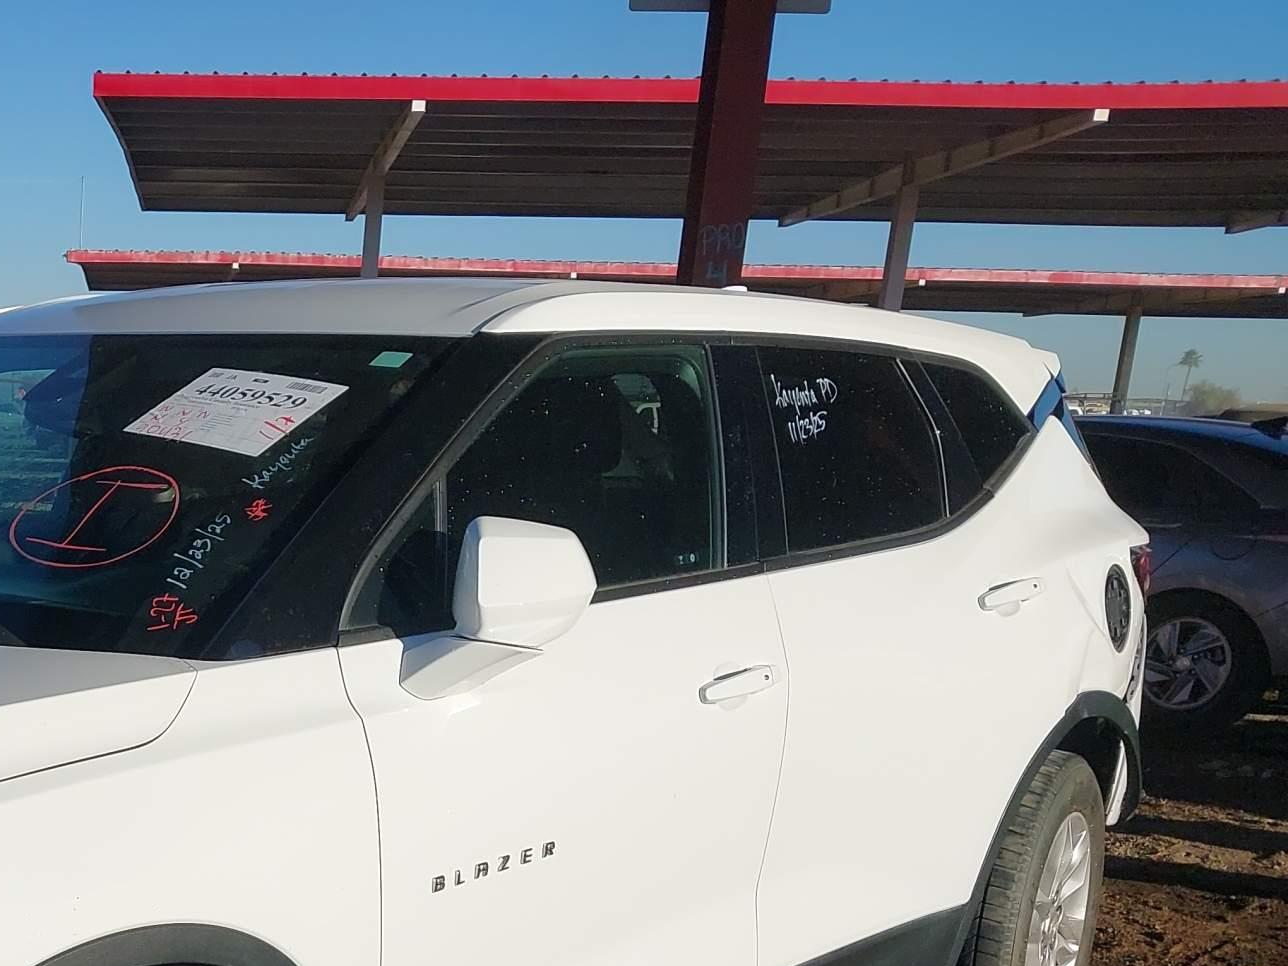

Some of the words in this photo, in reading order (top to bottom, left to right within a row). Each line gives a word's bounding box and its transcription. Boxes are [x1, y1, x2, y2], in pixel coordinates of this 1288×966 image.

[195, 383, 307, 409] 44059529
[816, 378, 838, 403] PD
[788, 411, 828, 445] 11/23/25
[166, 513, 232, 589] 12/23/25
[431, 840, 556, 893] BLAZER
